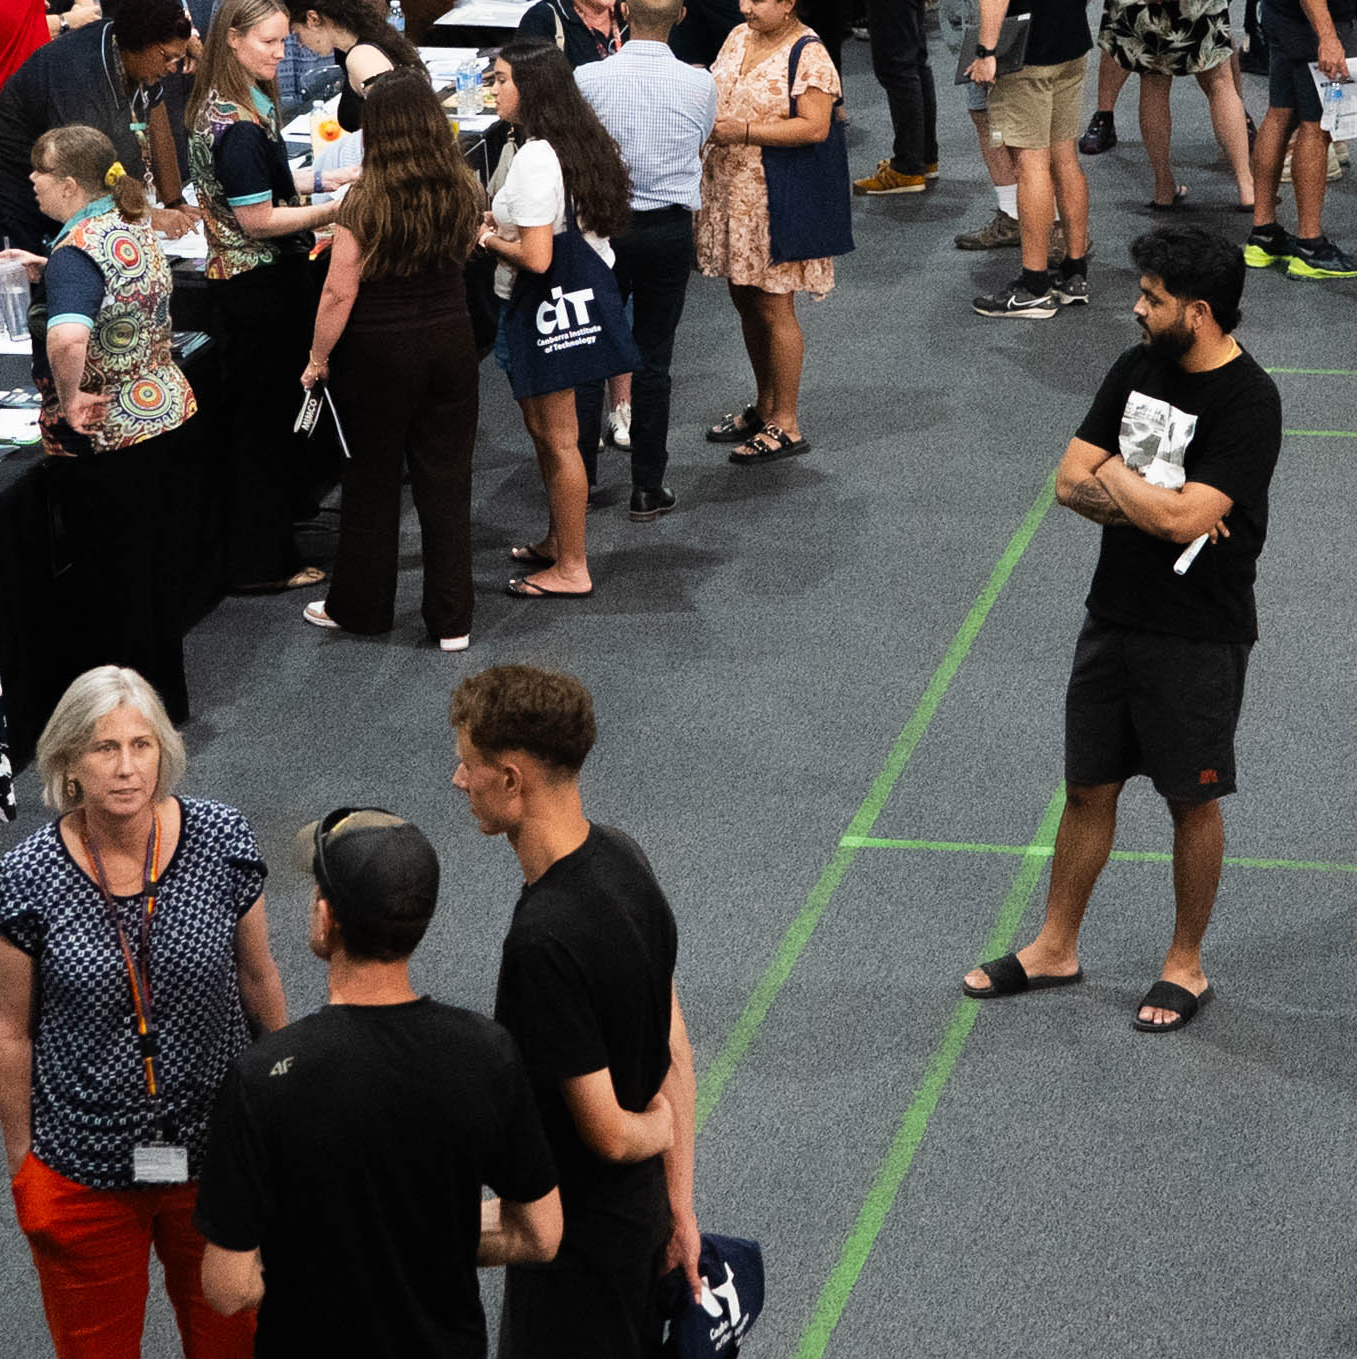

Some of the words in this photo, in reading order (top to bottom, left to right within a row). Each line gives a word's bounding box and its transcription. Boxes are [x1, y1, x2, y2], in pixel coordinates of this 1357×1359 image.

[536, 333, 569, 347] Canberra
[569, 325, 602, 339] Institute
[544, 345, 553, 354] of
[553, 336, 596, 351] Technology
